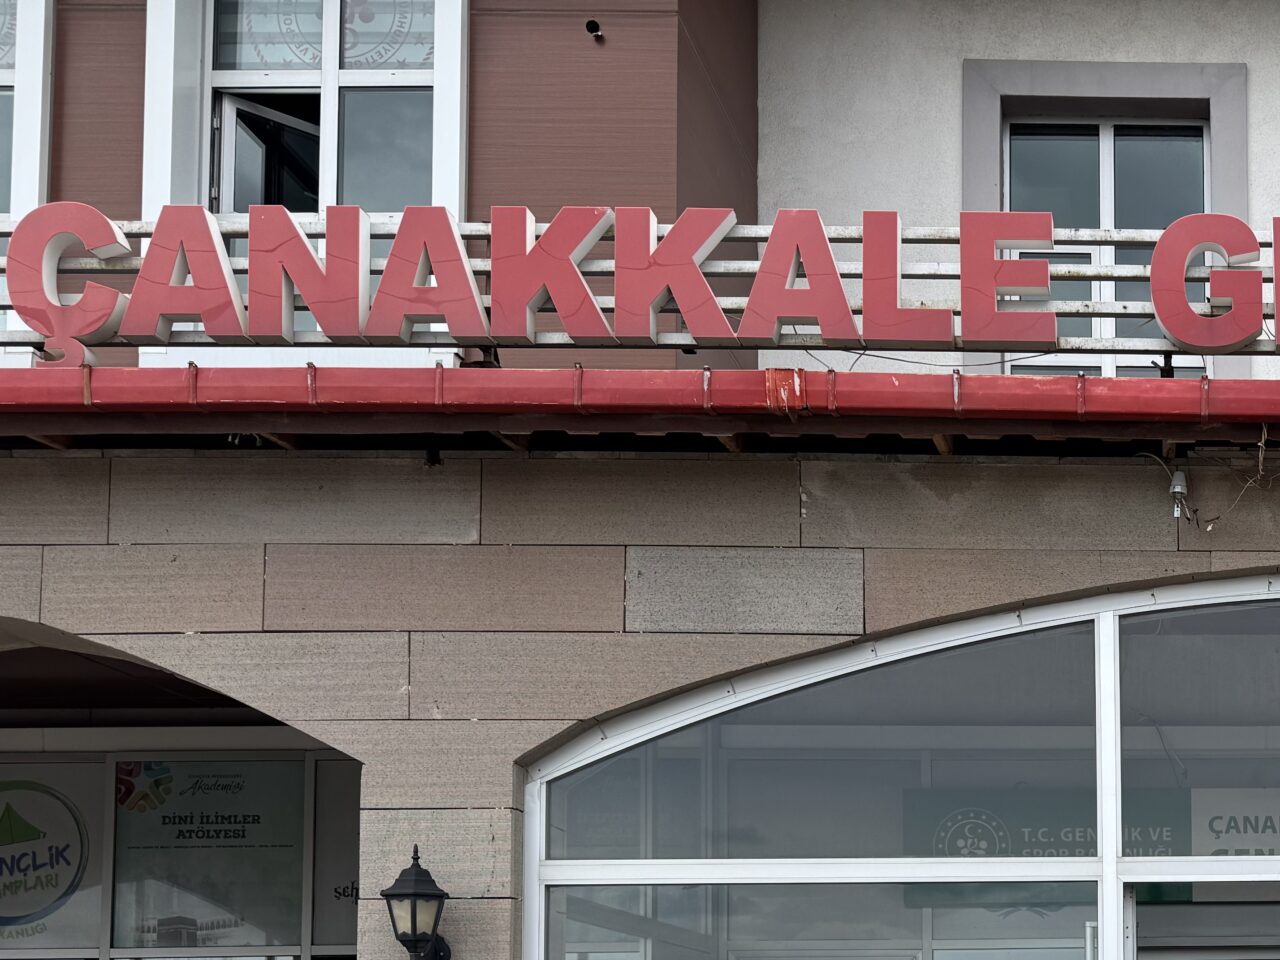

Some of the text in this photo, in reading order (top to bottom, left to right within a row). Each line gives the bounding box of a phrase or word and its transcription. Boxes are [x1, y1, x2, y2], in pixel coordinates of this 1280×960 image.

[6, 200, 1058, 367] ÇANAKKALE
[161, 811, 262, 826] DİNİ İLİMLER
[176, 825, 248, 840] ATÖLYESİ
[1021, 824, 1173, 843] T.C. GENİK VE
[0, 872, 60, 899] MPLARI
